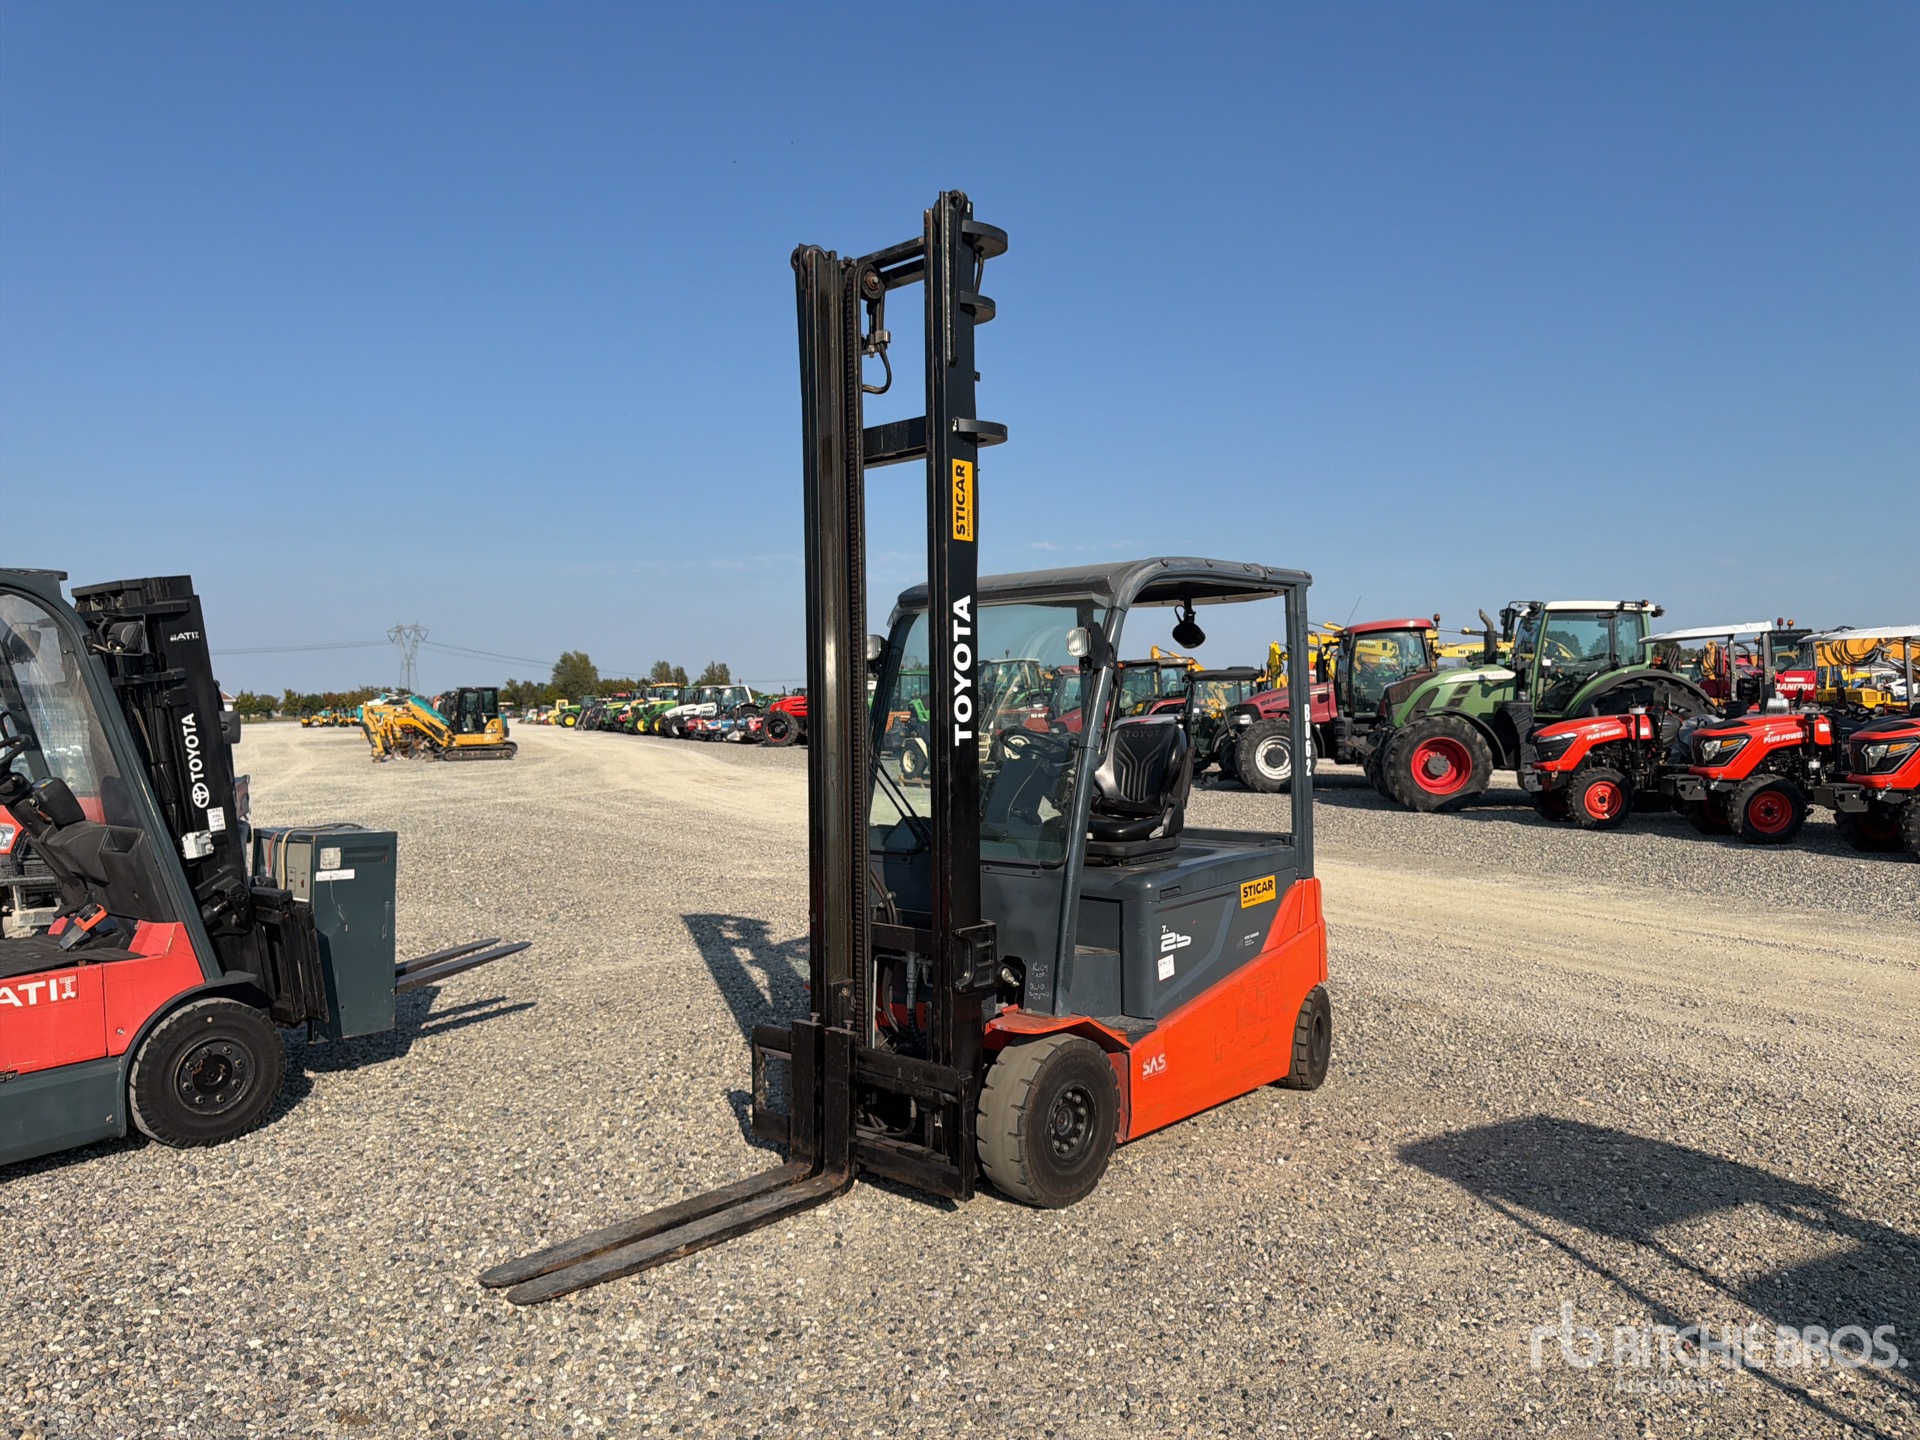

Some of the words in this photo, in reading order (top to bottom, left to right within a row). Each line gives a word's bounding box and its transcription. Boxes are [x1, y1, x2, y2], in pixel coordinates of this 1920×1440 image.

[955, 465, 966, 535] STICAR
[953, 594, 972, 746] TOYOTA
[181, 712, 204, 783] TOYOTA
[1586, 733, 1601, 741] PLUS
[1763, 735, 1780, 744] PLUS
[1243, 879, 1274, 899] STICAR
[1142, 1053, 1166, 1077] SAS
